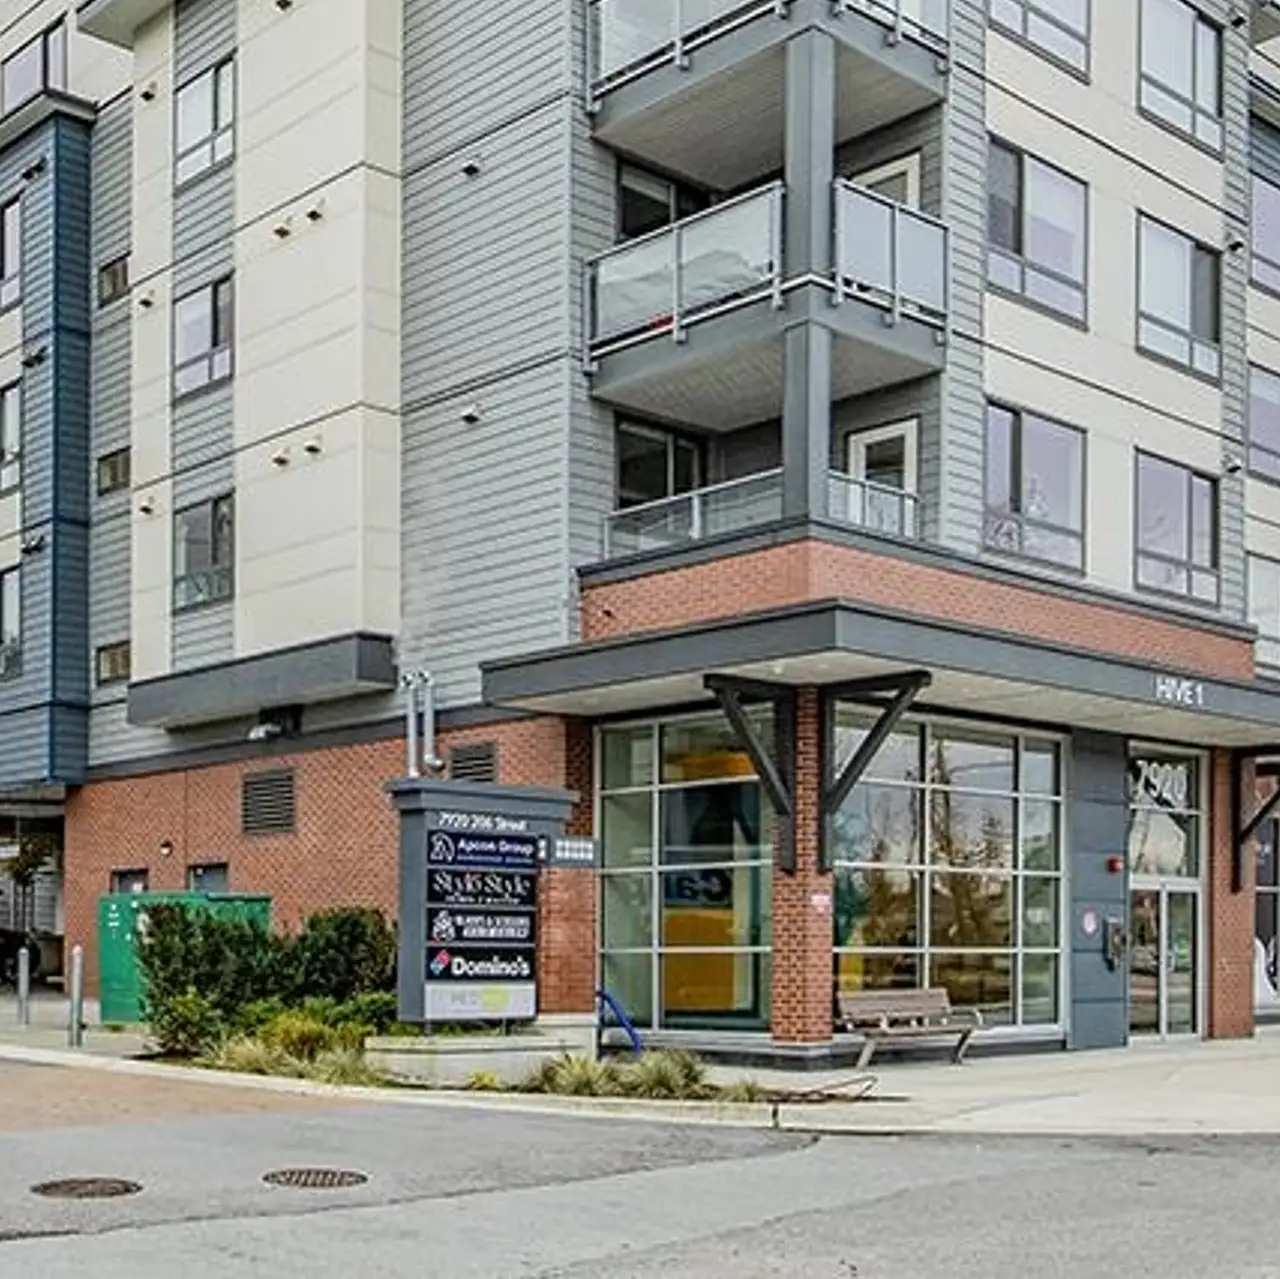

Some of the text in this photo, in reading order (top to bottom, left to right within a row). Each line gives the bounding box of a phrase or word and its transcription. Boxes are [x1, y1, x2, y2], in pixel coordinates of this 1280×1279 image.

[1195, 682, 1203, 706] 1
[1135, 758, 1188, 801] 7920
[450, 954, 531, 978] Domino's
